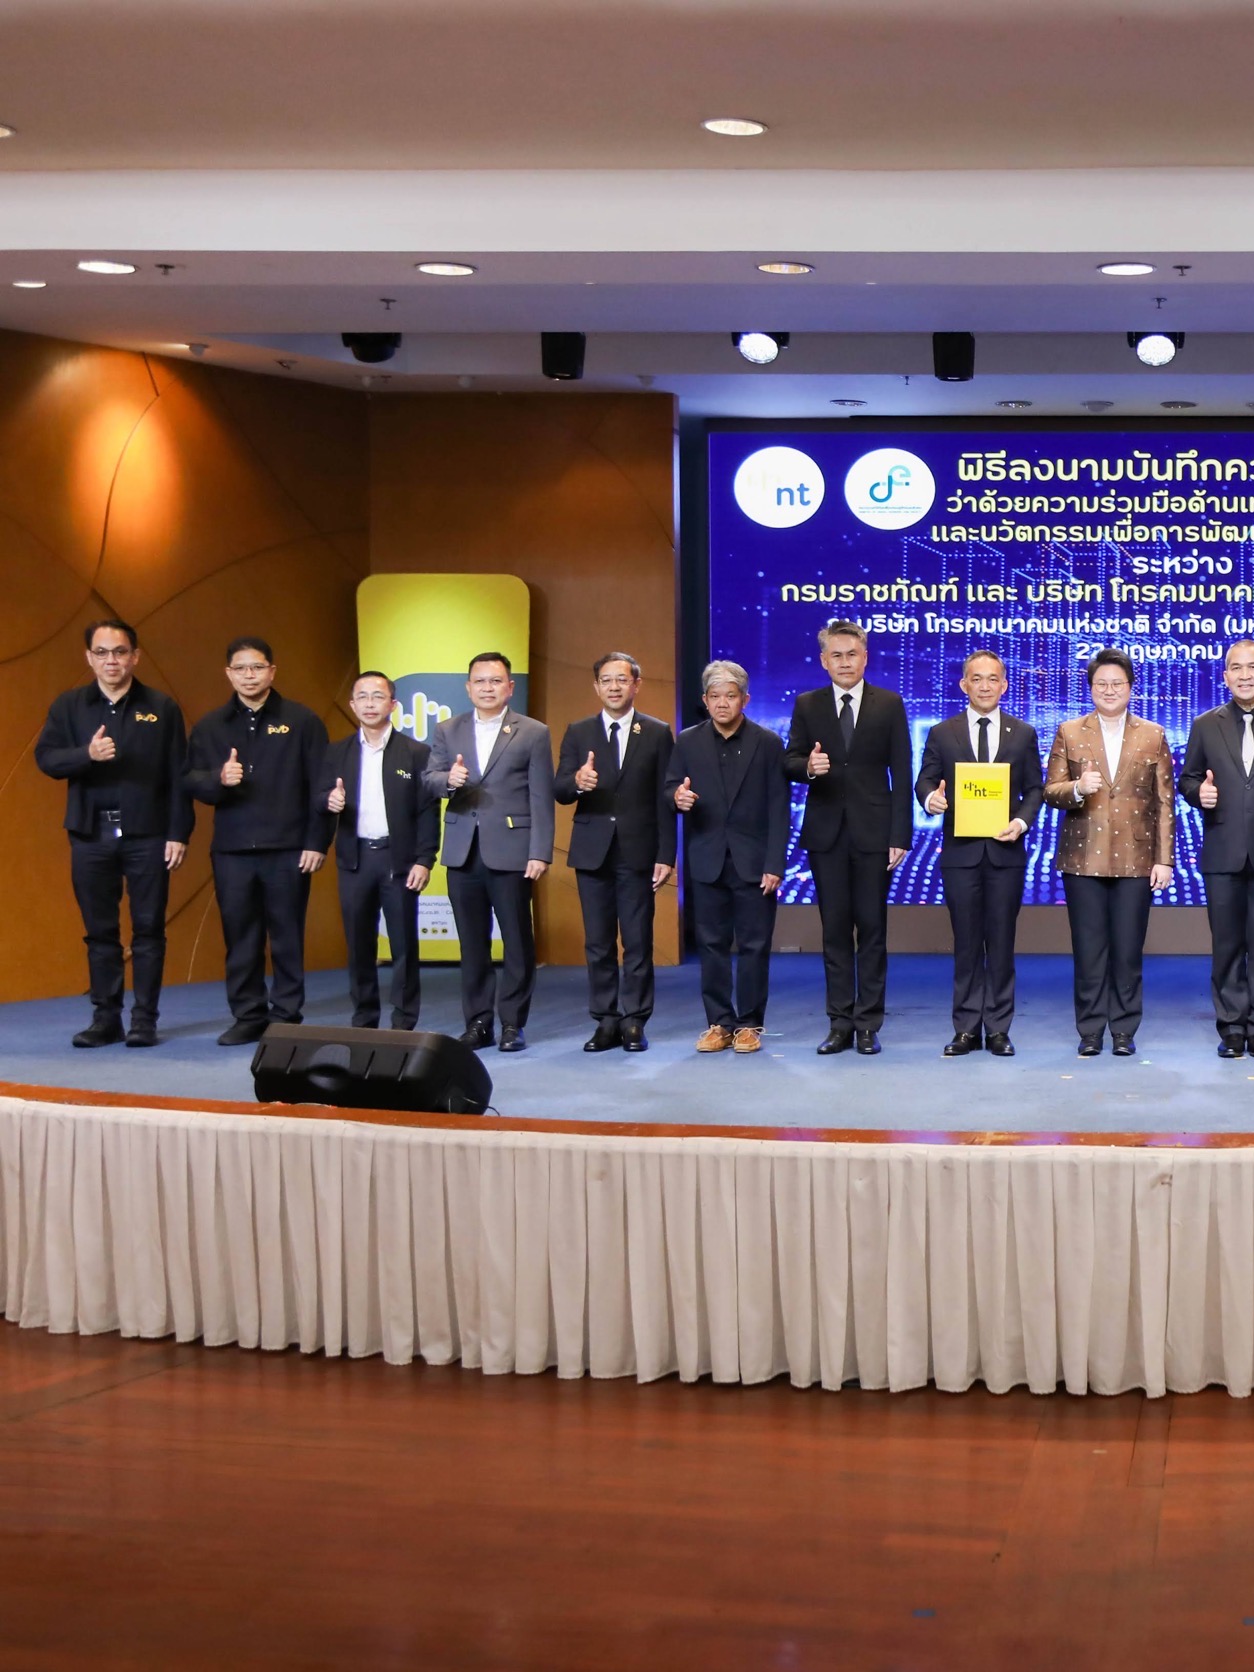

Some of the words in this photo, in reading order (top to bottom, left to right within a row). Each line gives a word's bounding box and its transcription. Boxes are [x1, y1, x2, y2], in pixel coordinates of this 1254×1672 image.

[776, 483, 811, 507] nt
[1132, 554, 1233, 575] ระหว่าง
[781, 577, 960, 603] กรมราชทัณฑ์
[967, 584, 1018, 602] และ
[1027, 577, 1102, 603] บริษัท
[924, 611, 1150, 634] โทรคมนาคมแห่งชาติ
[1156, 613, 1217, 634] จำกัด
[974, 787, 988, 797] nt
